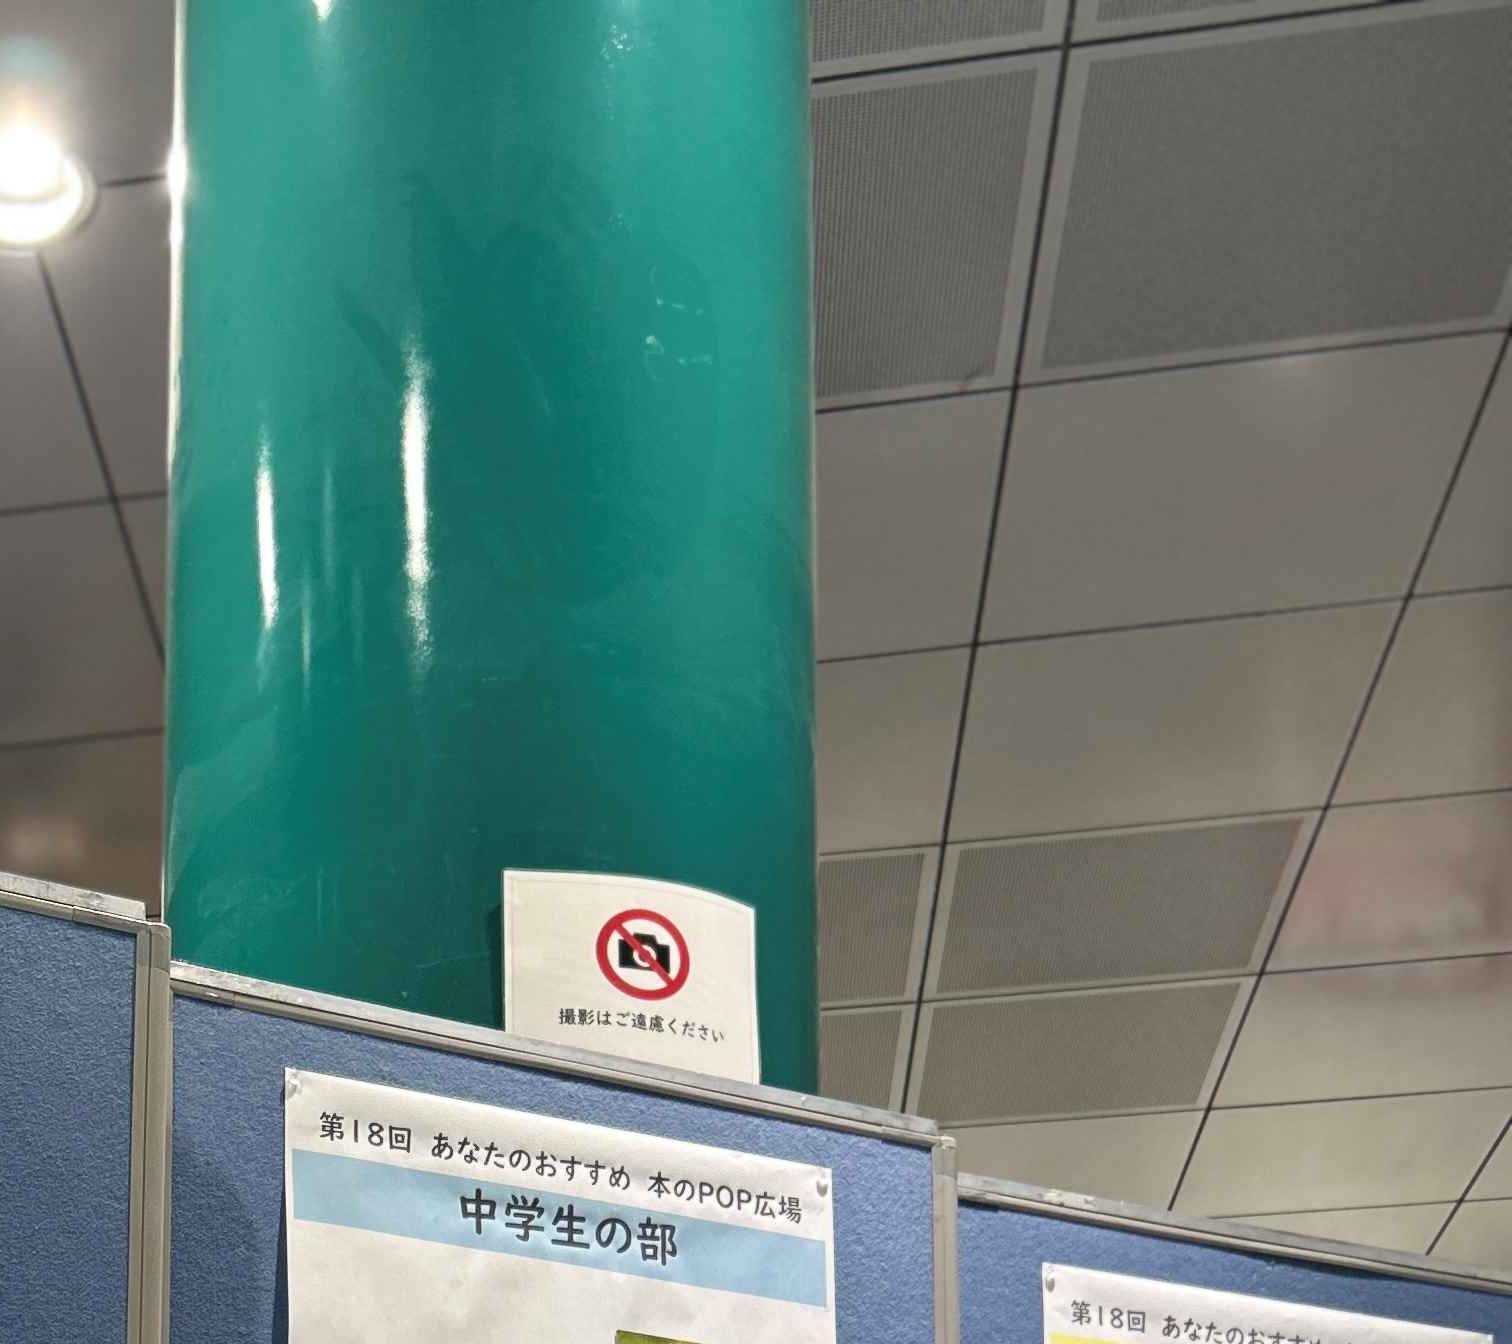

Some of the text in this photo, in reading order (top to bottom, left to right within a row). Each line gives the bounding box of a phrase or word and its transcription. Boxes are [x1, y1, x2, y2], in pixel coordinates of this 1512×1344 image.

[559, 1007, 724, 1043] 撮影はご遠慮ください
[319, 1111, 803, 1225] 第18回 あなたのおすすめ 本のPOP広場
[458, 1188, 678, 1267] 中学生の部
[1070, 1302, 1147, 1334] 第18回
